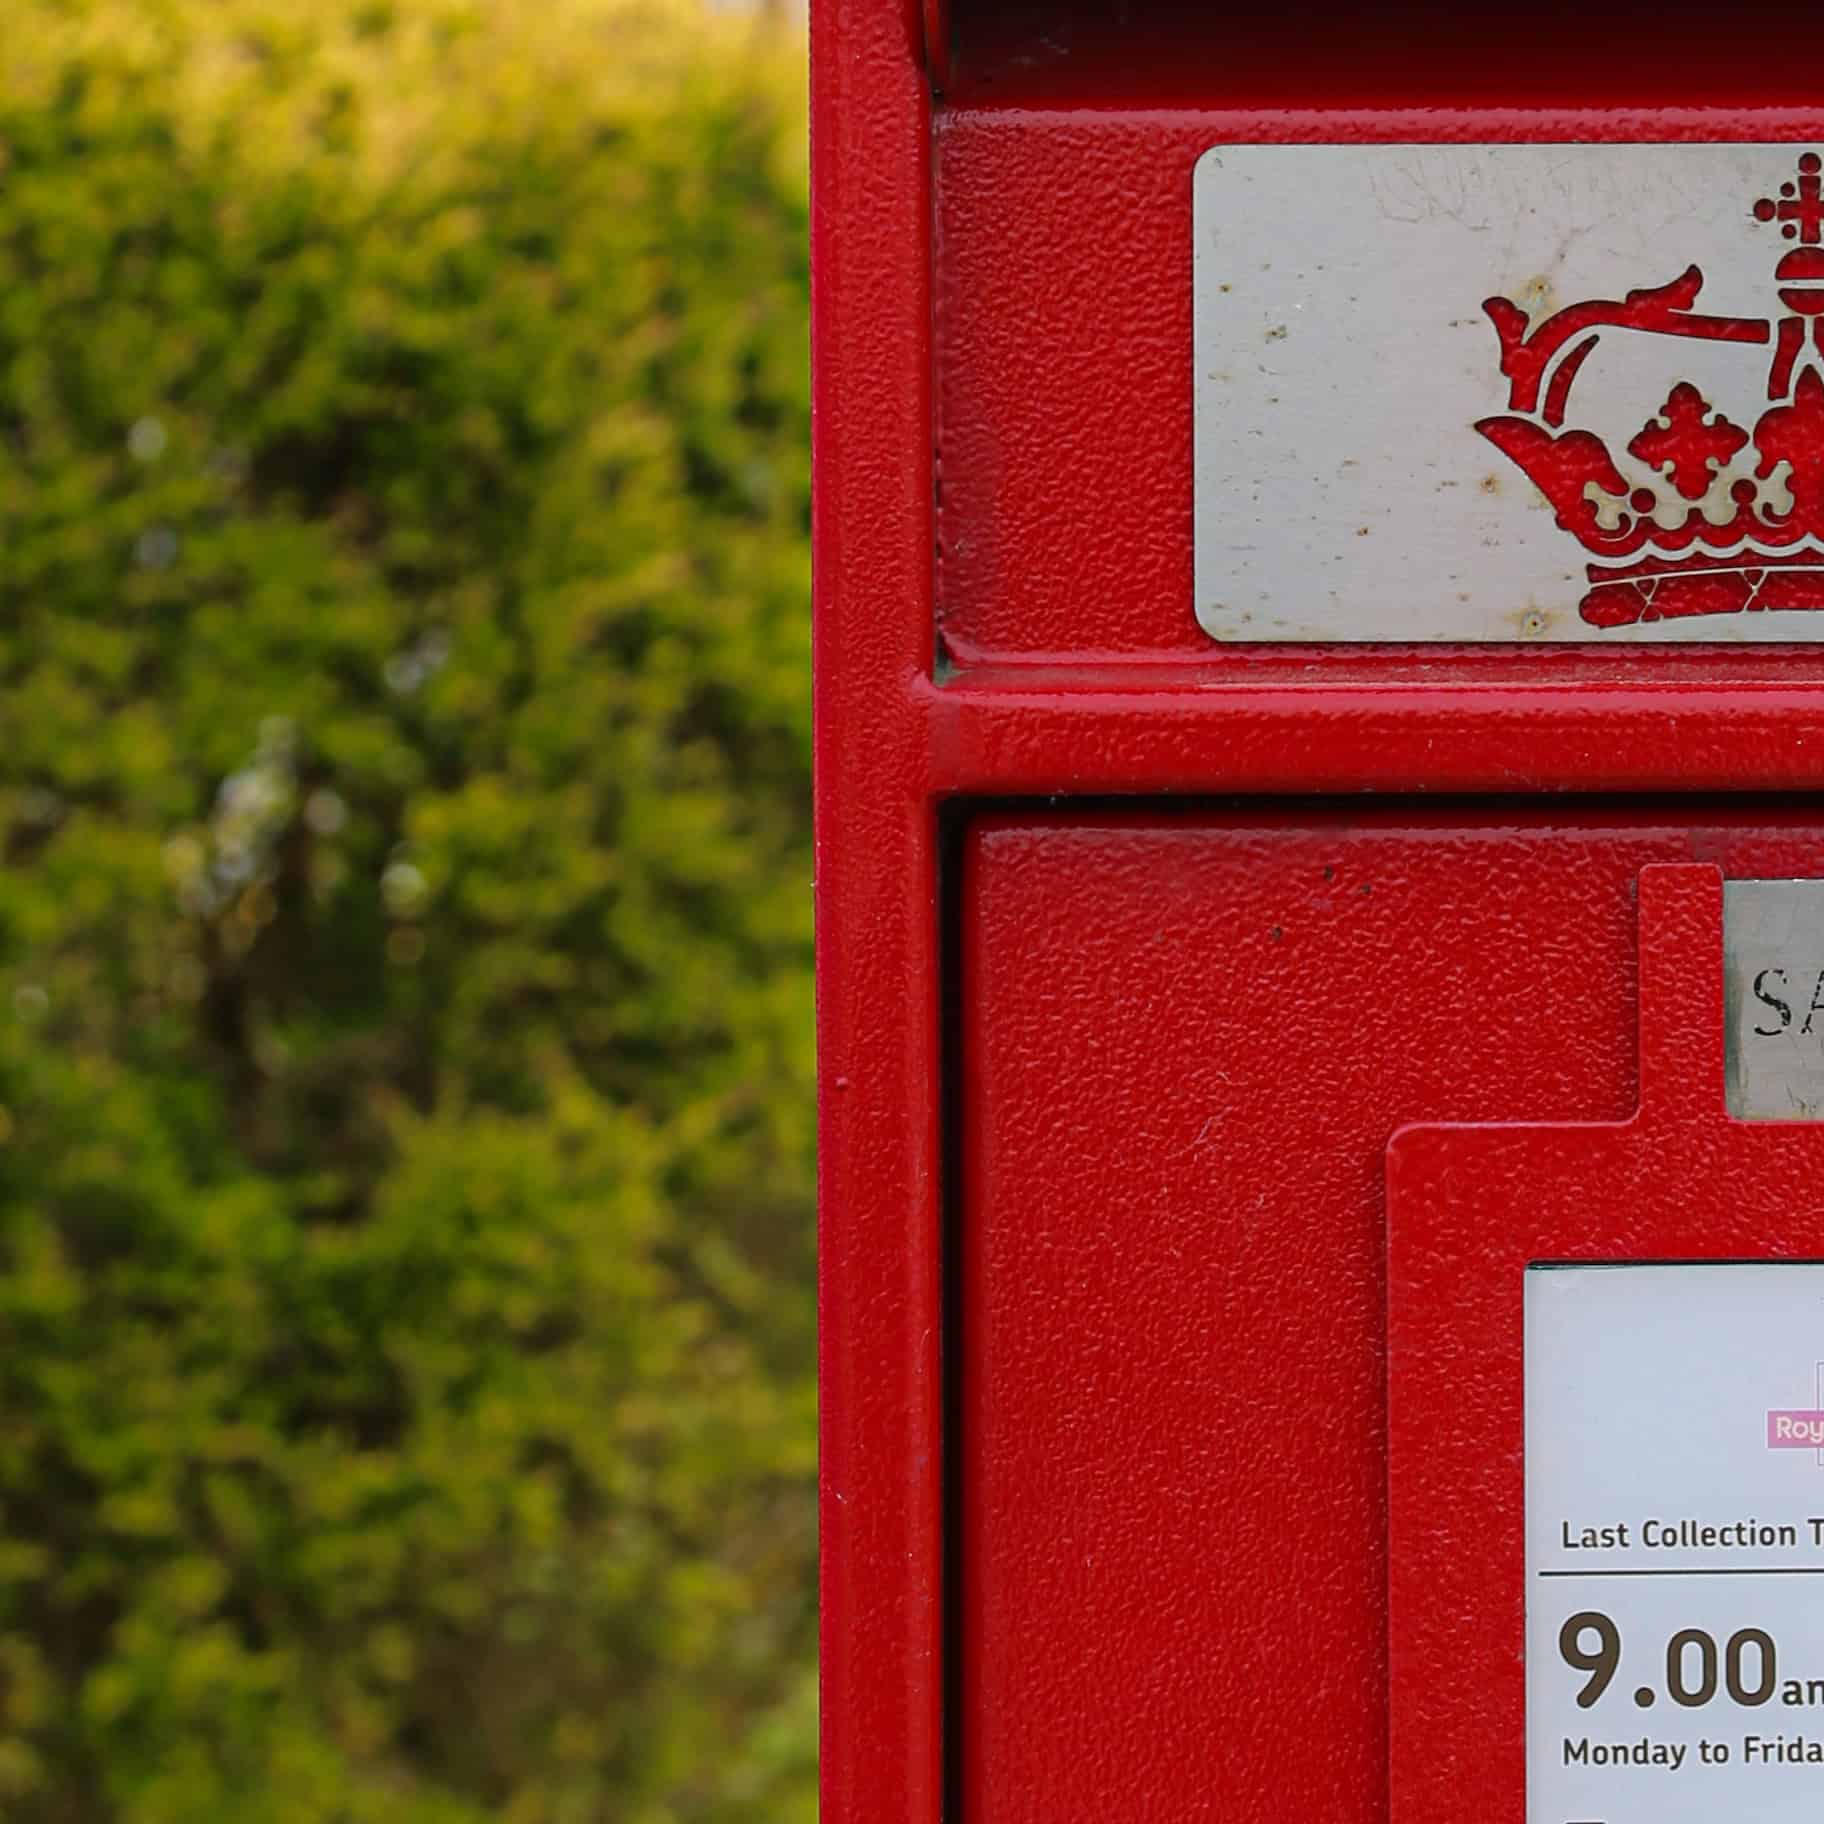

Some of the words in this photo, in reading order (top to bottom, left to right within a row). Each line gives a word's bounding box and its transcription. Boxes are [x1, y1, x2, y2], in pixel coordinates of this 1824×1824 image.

[1563, 1522, 1629, 1548] Last
[1643, 1520, 1795, 1547] Collection
[1564, 1738, 1686, 1770] Monday
[1699, 1740, 1728, 1763] to
